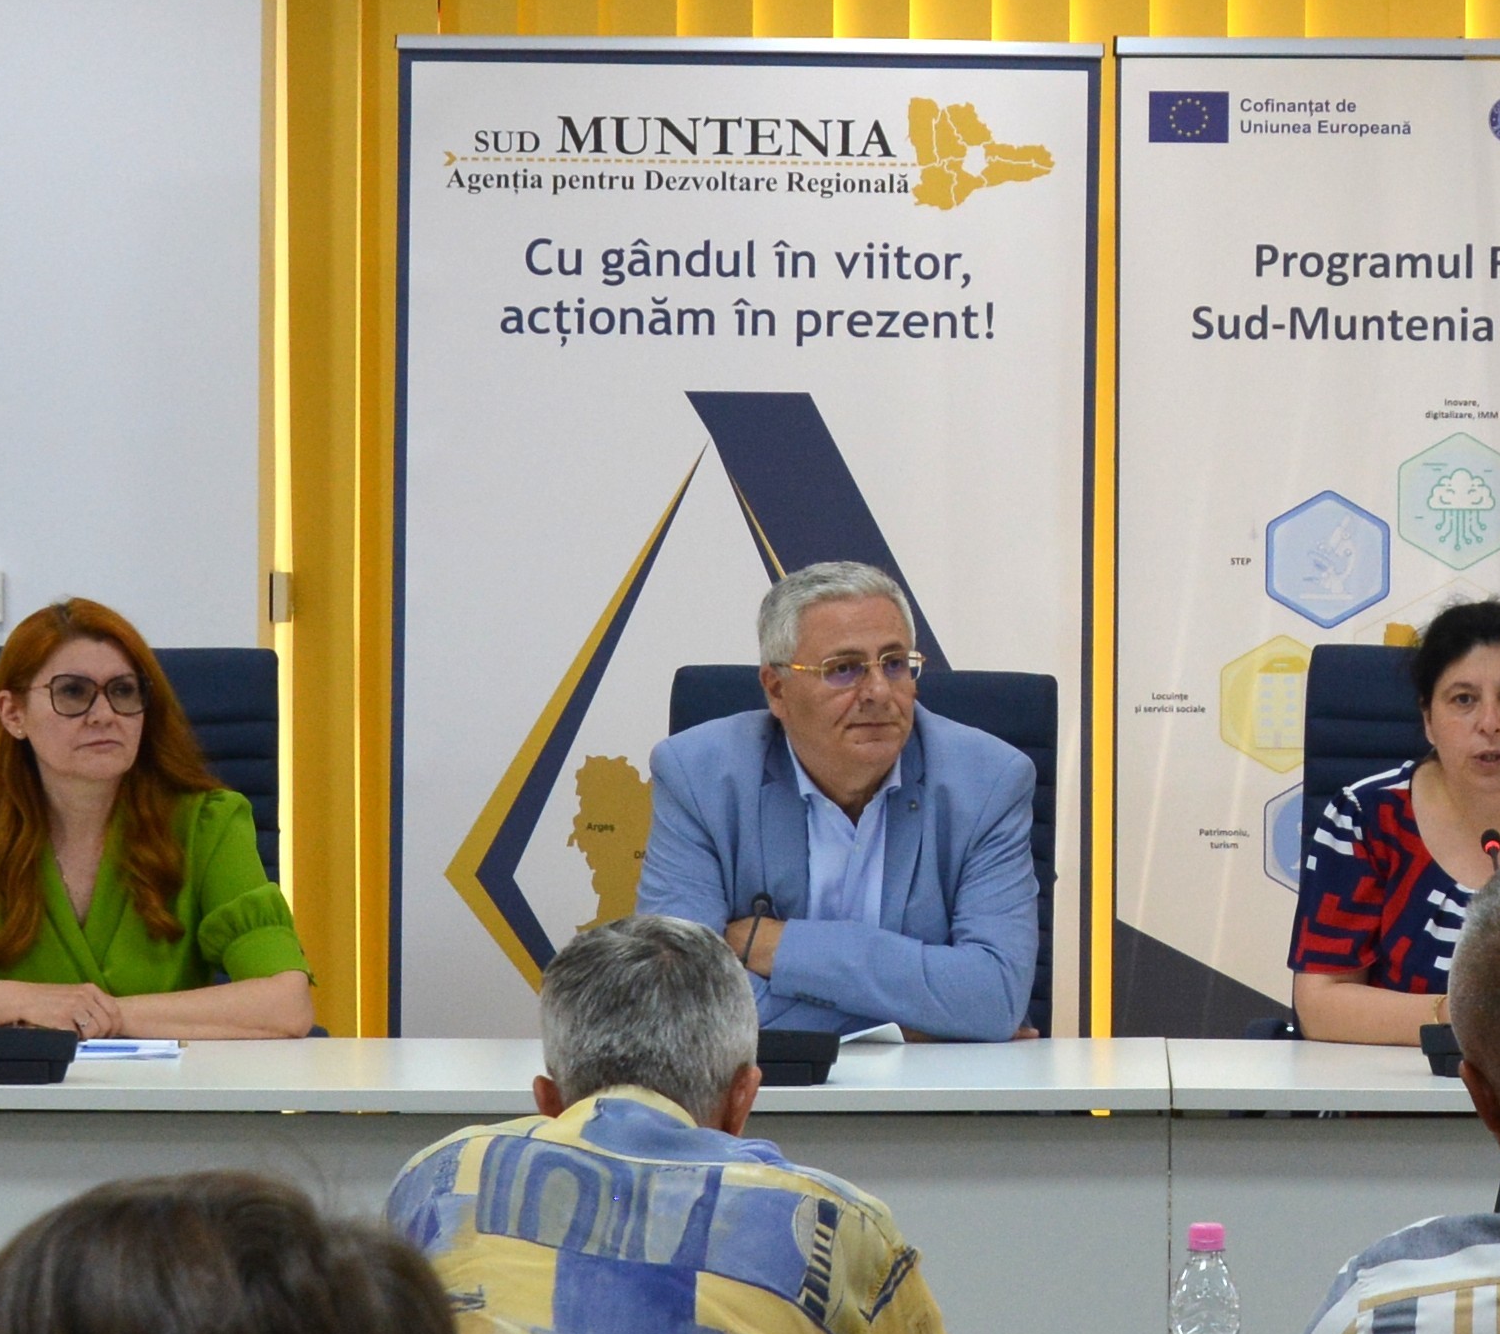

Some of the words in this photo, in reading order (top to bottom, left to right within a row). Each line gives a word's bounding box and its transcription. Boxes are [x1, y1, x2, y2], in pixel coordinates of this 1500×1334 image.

[1241, 99, 1330, 116] Cofinanțat
[1336, 99, 1356, 112] de
[475, 131, 540, 153] SUD
[554, 116, 896, 157] MUNTENIA
[1241, 120, 1311, 134] Uniunea
[1318, 120, 1411, 137] Europeană
[447, 169, 542, 194] Agenția
[553, 172, 634, 195] pentru
[646, 170, 777, 191] Dezvoltare
[788, 172, 908, 198] Regională
[526, 238, 582, 275] Cu
[602, 238, 756, 286] gândul
[773, 240, 815, 278] în
[835, 242, 971, 288] viitor,
[1256, 244, 1472, 286] Programul
[501, 297, 714, 347] acționăm
[733, 298, 775, 336] în
[796, 302, 993, 347] prezent!
[1192, 305, 1493, 341] Sud-Muntenia
[1444, 398, 1480, 408] Inovare,
[1425, 410, 1476, 420] digitalizare,
[1477, 411, 1499, 419] IMM
[1230, 557, 1252, 566] STEP
[1151, 693, 1189, 702] Locuințe
[1199, 828, 1250, 838] Patrimoniu,
[1209, 841, 1239, 850] turism
